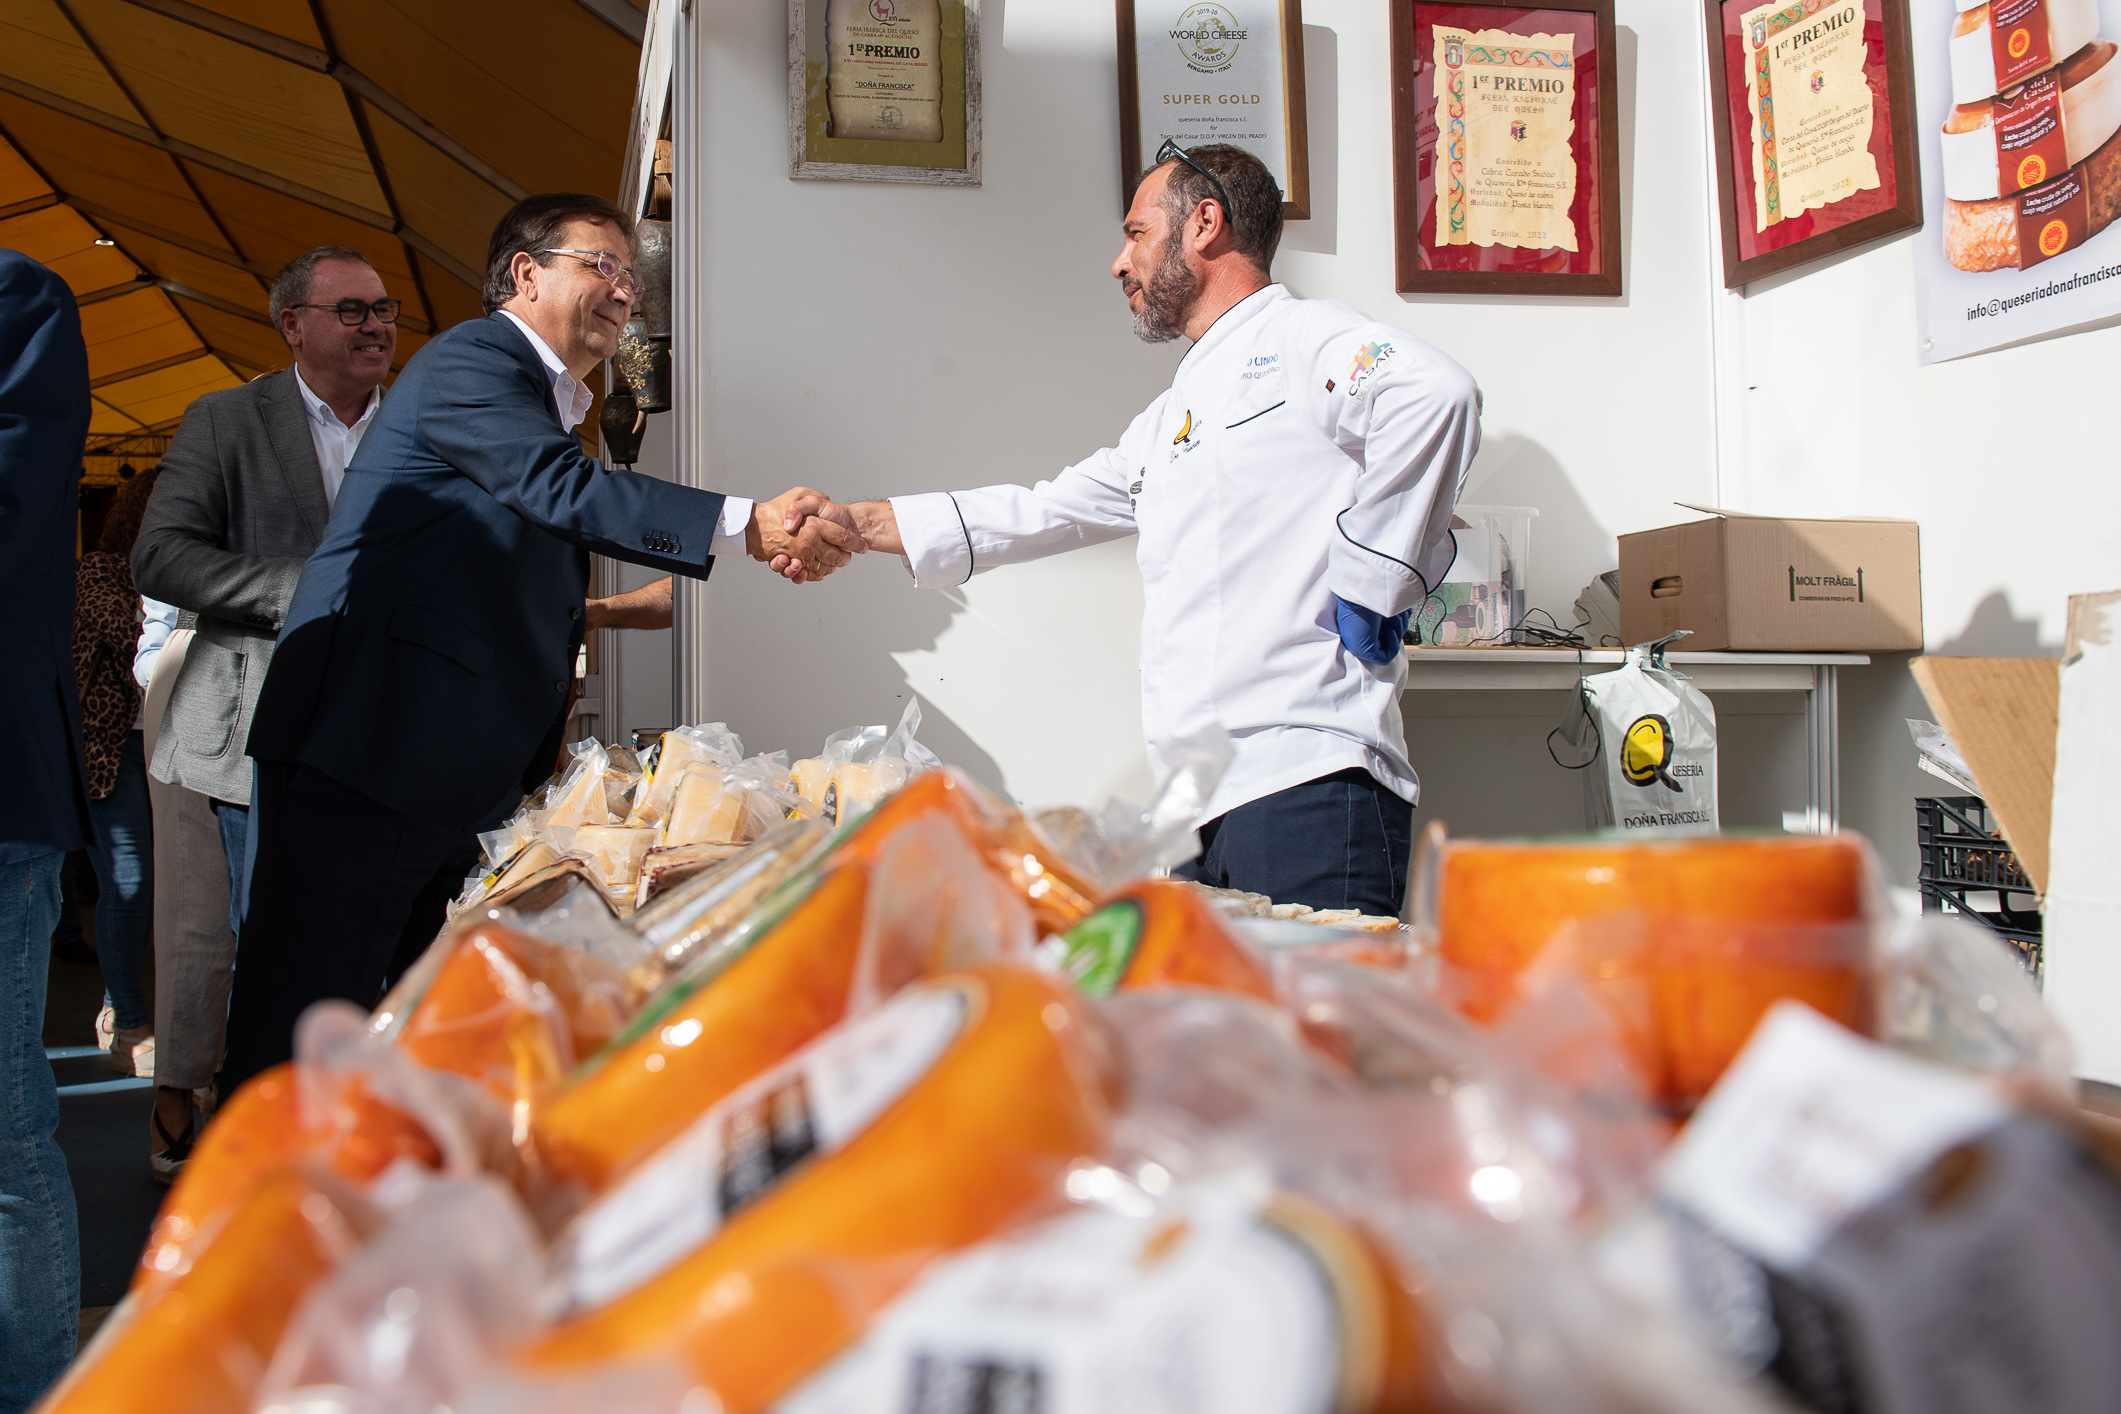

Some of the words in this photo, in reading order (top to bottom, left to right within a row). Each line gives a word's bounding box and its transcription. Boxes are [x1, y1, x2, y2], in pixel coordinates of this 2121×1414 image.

[1169, 30, 1209, 40] WORLD
[1211, 30, 1248, 40] CHEESE
[1775, 39, 1789, 60] 1er
[1792, 7, 1855, 50] PREMIO
[864, 44, 920, 60] PREMIO
[1192, 51, 1226, 62] AWARDS
[1187, 63, 1214, 74] BERGAMO
[1218, 63, 1232, 73] ITALY
[1472, 75, 1489, 89] 1er
[1494, 76, 1564, 94] PREMIO
[2030, 76, 2047, 89] del
[2024, 81, 2056, 100] Casar
[1163, 94, 1212, 104] SUPER
[1218, 94, 1260, 104] GOLD
[1800, 108, 1831, 126] Concedido
[2001, 142, 2013, 150] cuajo
[2014, 136, 2030, 147] vegetal
[2030, 129, 2044, 140] natural
[2048, 120, 2056, 130] sal
[2004, 132, 2018, 141] Leche
[2018, 128, 2031, 137] cruda
[1810, 144, 1829, 156] Queso
[1830, 140, 1838, 148] de
[1495, 158, 1532, 166] Concedido
[1814, 155, 1833, 171] Pasta
[1481, 168, 1502, 176] Cabra
[1505, 168, 1530, 176] Curado
[1470, 188, 1504, 196] Variedad:
[1506, 188, 1527, 198] Queso
[2022, 207, 2036, 215] cuajo
[2036, 202, 2053, 213] vegetal
[2053, 193, 2069, 206] natural
[2072, 184, 2081, 194] sal
[2026, 198, 2041, 206] Leche
[2041, 193, 2054, 203] cruda
[1510, 200, 1531, 213] Pasta
[1533, 201, 1554, 209] blanda
[1527, 231, 1546, 239] 2022
[1967, 264, 2121, 321] info@queseriadonafrancisca
[1349, 348, 1396, 396] CASAR
[1356, 390, 1367, 401] DE
[1796, 576, 1822, 586] MOLT
[1824, 575, 1857, 586] FRÀGIL
[1624, 813, 1658, 829] DOÑA
[1659, 810, 1700, 825] FRANCISCA
